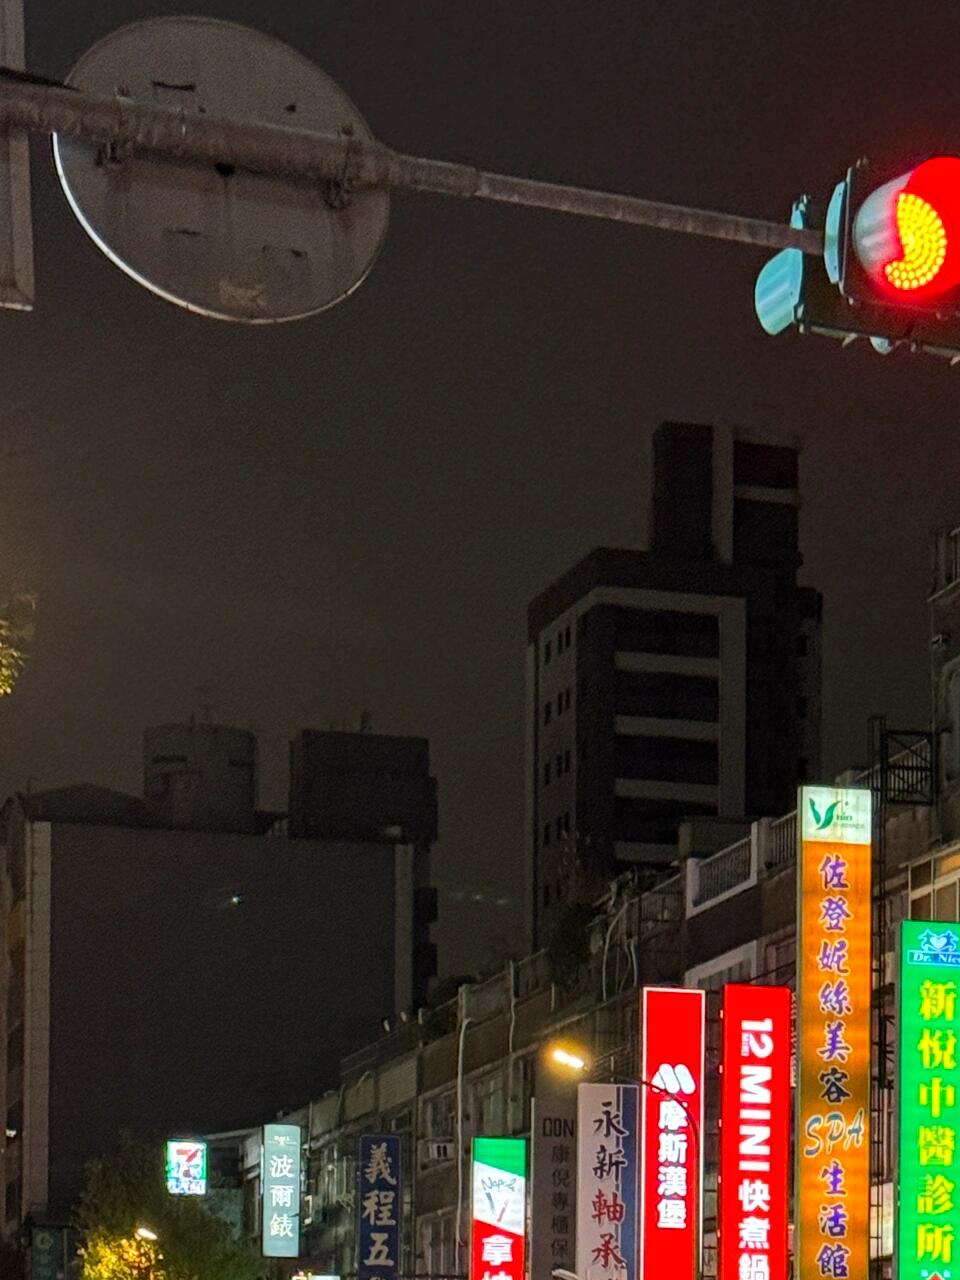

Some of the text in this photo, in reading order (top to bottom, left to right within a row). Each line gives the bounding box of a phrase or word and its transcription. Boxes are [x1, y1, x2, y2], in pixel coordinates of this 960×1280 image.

[912, 953, 931, 963] Dr.
[740, 1017, 775, 1059] 12
[657, 1101, 689, 1230] 摩斯漢堡
[738, 1065, 773, 1172] MINI
[803, 1107, 867, 1158] SPA
[917, 979, 957, 1264] 新悅中醫診所
[816, 1161, 852, 1278] 生活館
